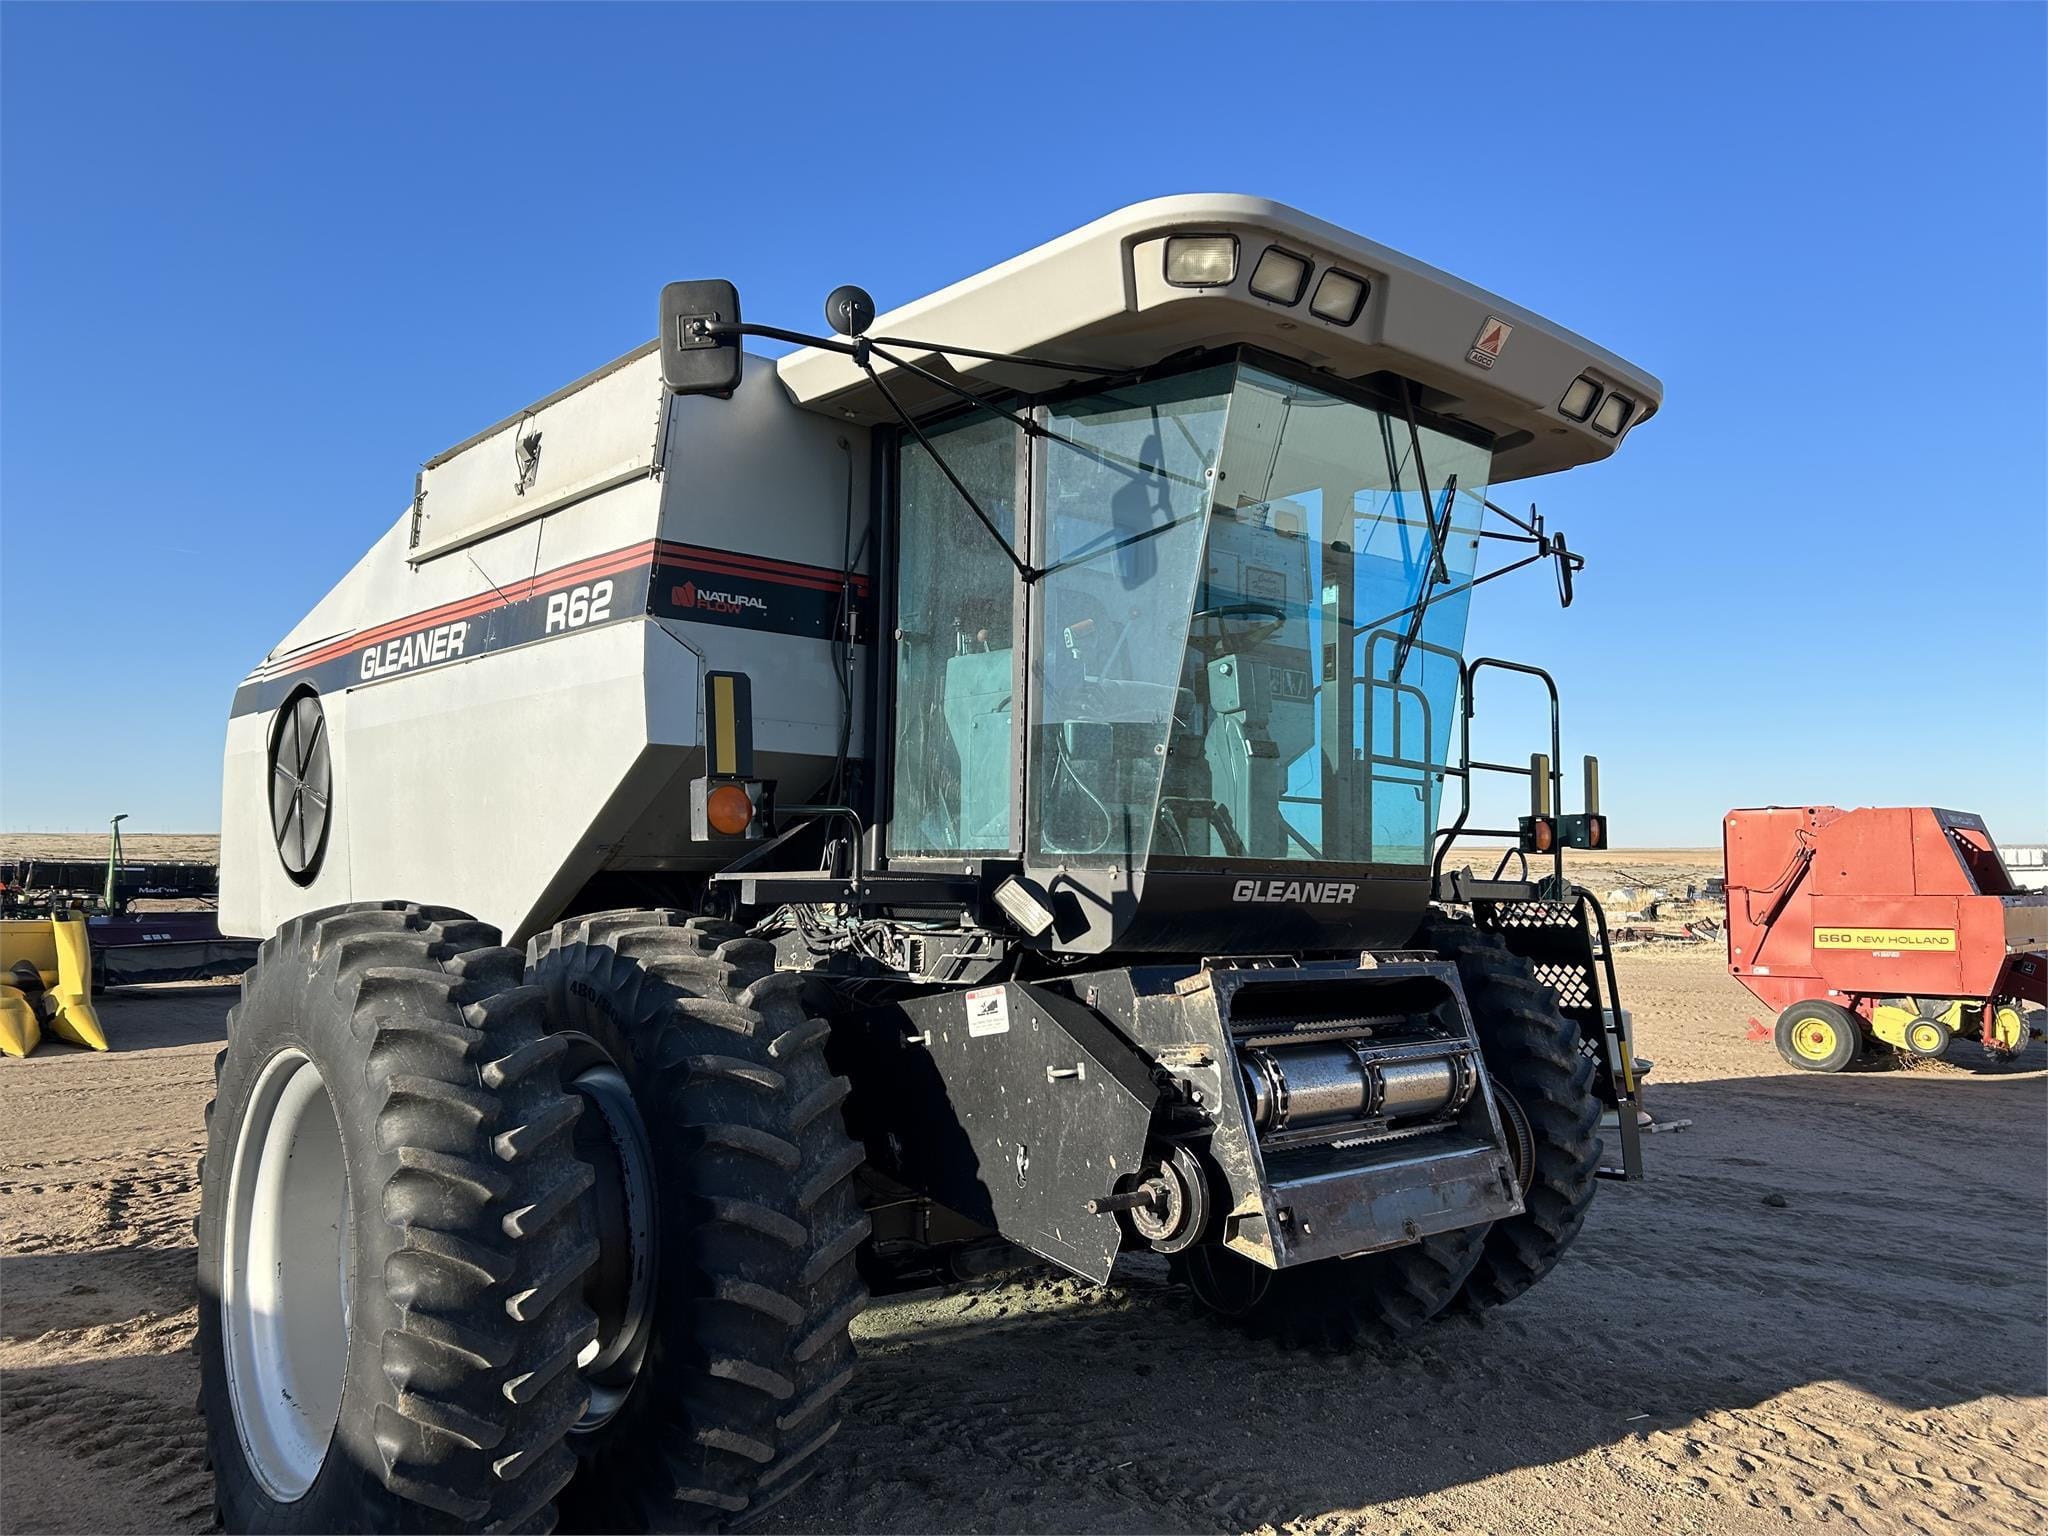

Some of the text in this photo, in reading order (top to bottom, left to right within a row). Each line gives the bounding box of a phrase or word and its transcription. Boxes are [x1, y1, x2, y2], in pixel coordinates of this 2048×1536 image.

[1472, 353, 1492, 366] AGCO
[545, 579, 613, 633] R62
[697, 589, 768, 610] NATURAL
[697, 600, 742, 615] FLOW
[361, 621, 469, 680] GLEANER
[1232, 880, 1357, 904] GLEANER
[1818, 934, 1949, 945] 660 NEW HOLLAND
